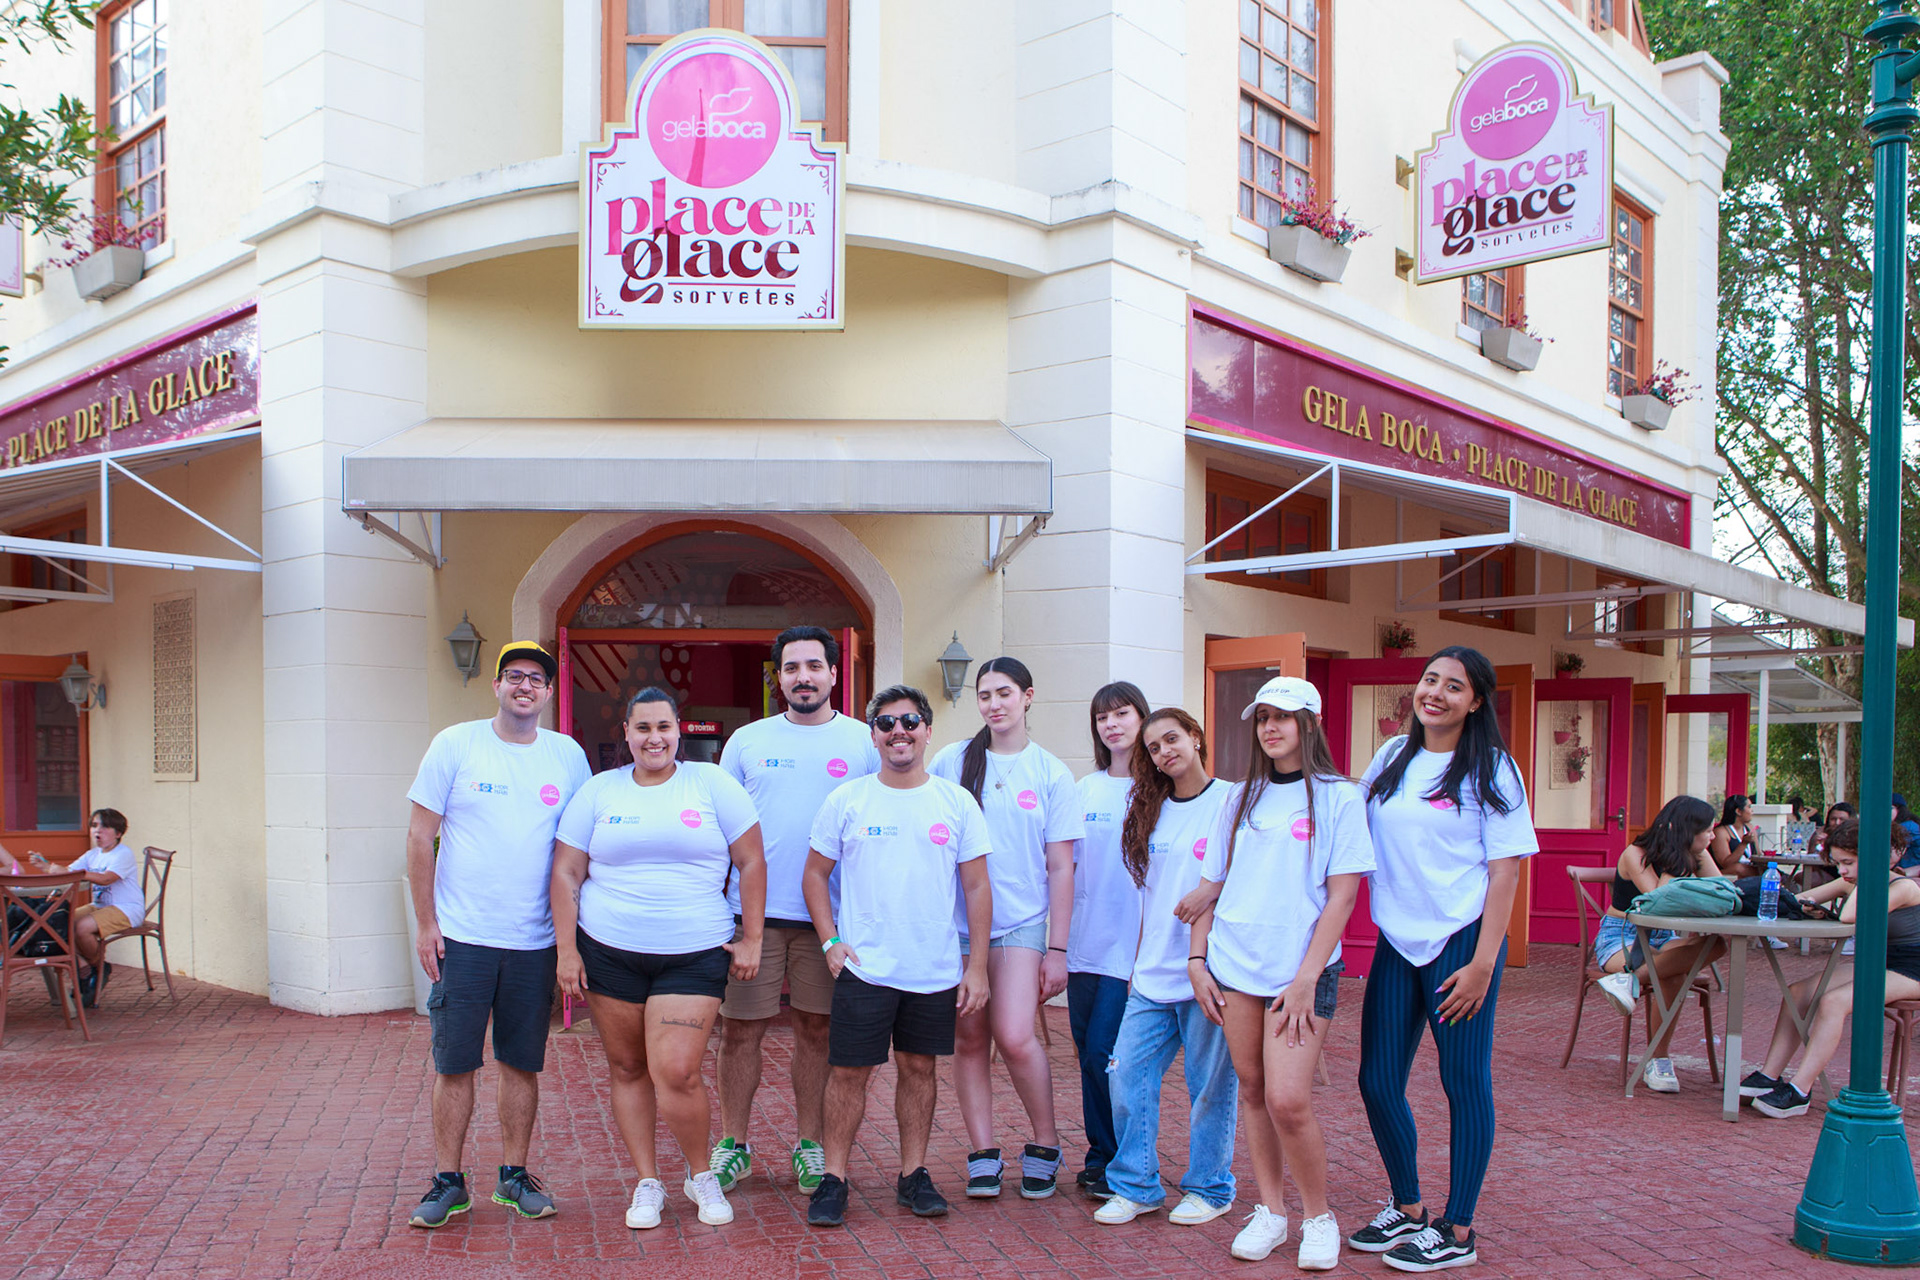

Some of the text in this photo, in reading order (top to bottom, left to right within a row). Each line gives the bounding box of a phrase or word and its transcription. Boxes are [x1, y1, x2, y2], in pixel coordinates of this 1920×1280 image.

[662, 115, 766, 142] gelaboca
[1470, 97, 1548, 133] gelaboca
[1431, 150, 1588, 227] place DE
[1565, 163, 1589, 180] LA
[604, 177, 815, 256] place DE
[788, 219, 816, 236] LA
[1442, 182, 1576, 257] glace
[1481, 221, 1573, 250] sorvetes
[619, 221, 800, 304] glace
[673, 288, 795, 306] sorvetes
[8, 350, 237, 468] PLACE DE LA GLACE
[1303, 385, 1638, 528] GELA BOCA PLACE DE LA GLACE
